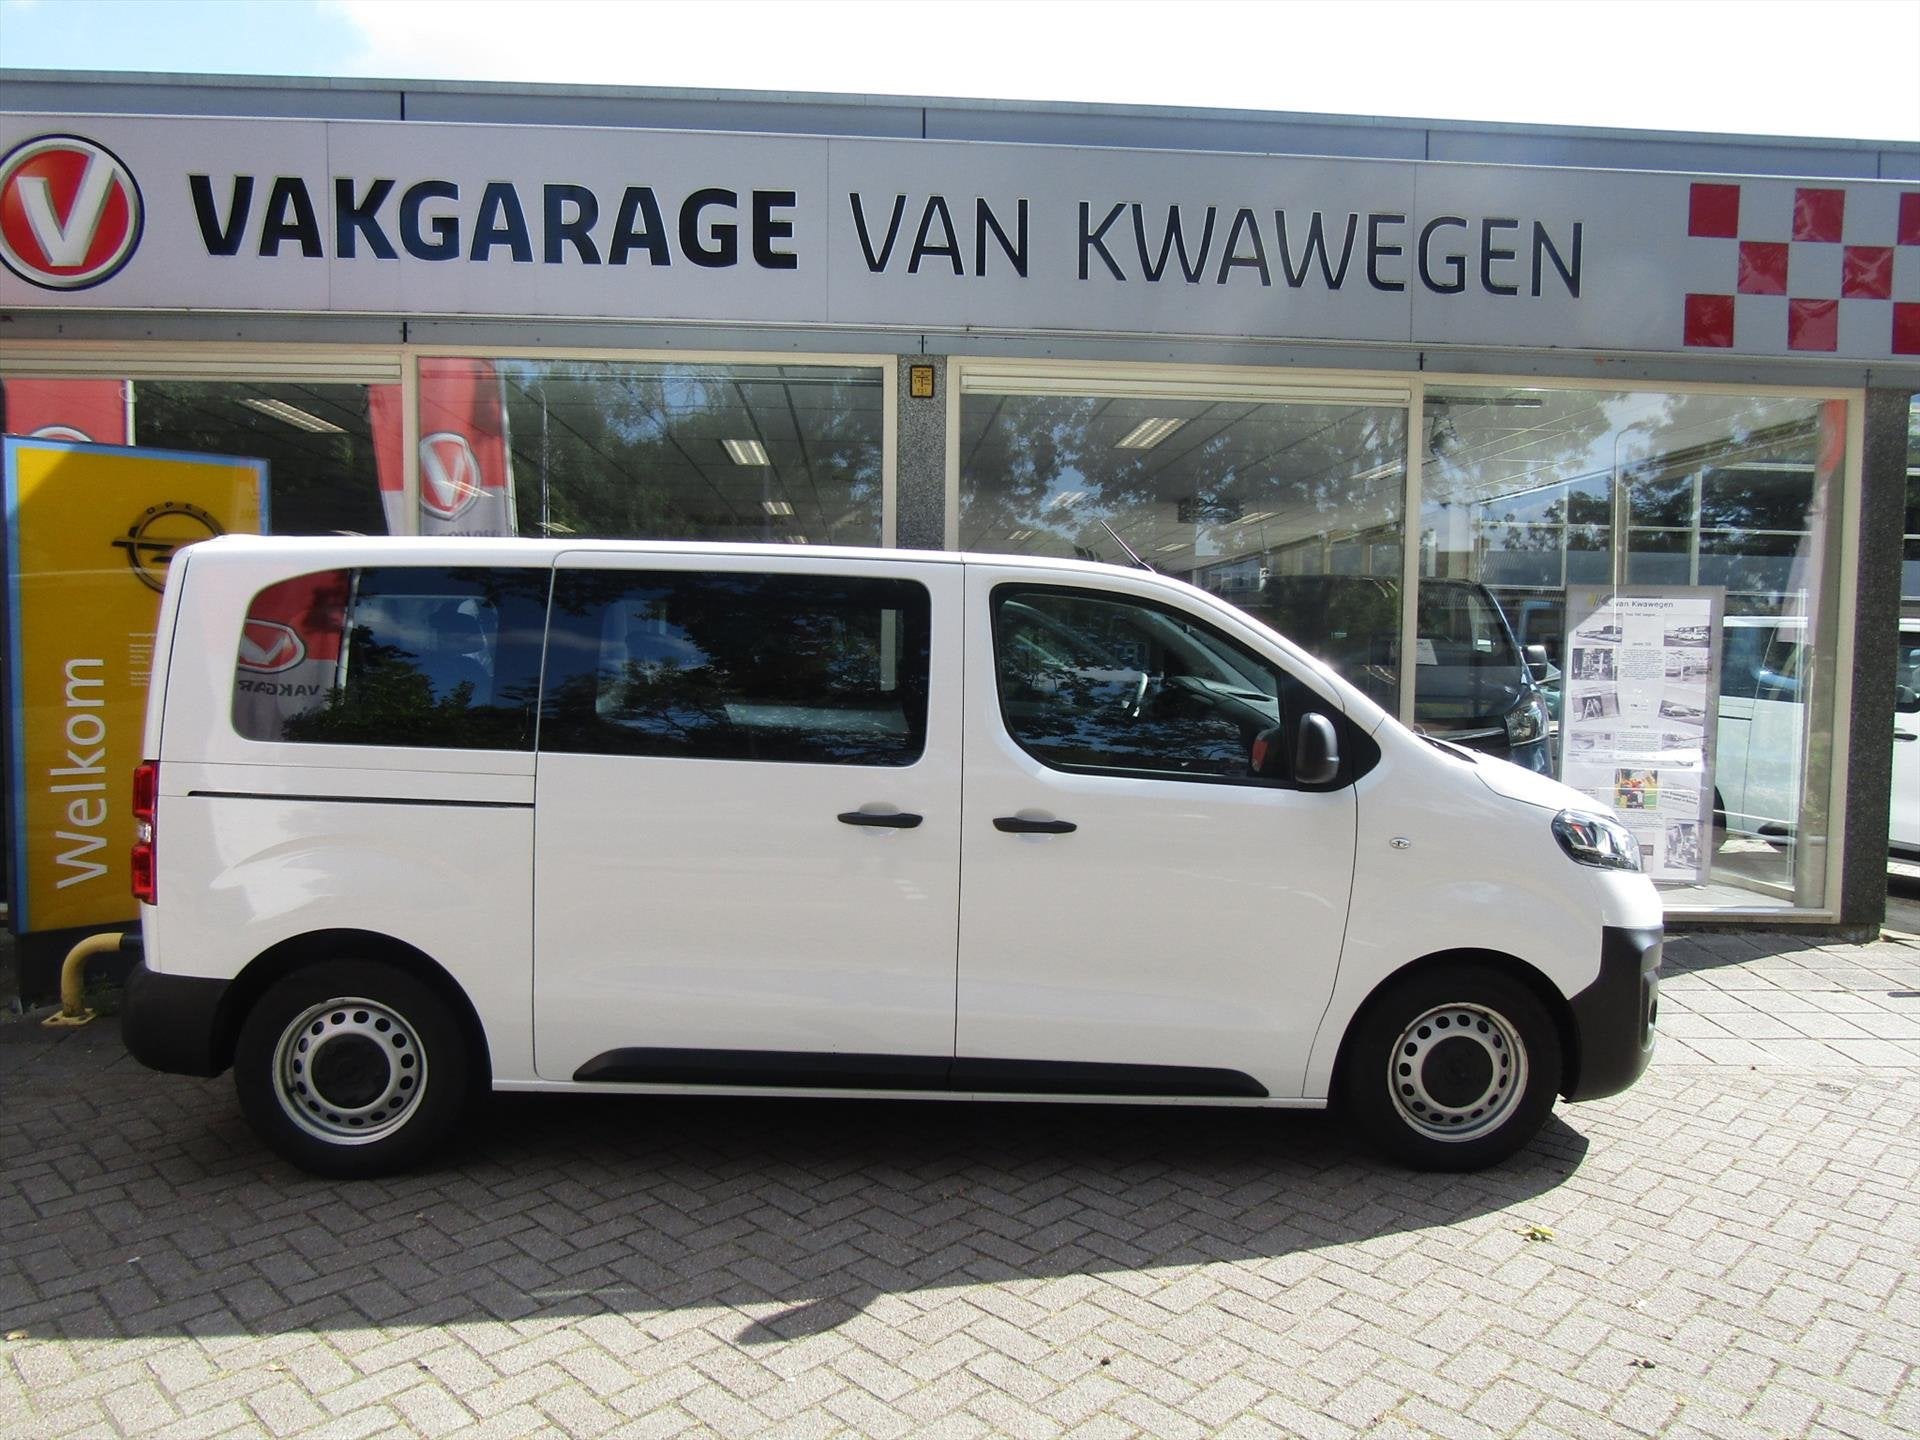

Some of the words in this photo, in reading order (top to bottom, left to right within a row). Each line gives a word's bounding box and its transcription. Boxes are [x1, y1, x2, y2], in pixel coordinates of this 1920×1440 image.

[188, 174, 798, 270] VAKGARAGE
[849, 192, 1029, 279] VAN
[1078, 200, 1584, 299] KWAWEGEN
[146, 501, 208, 518] OPEL
[50, 659, 108, 889] Welkom
